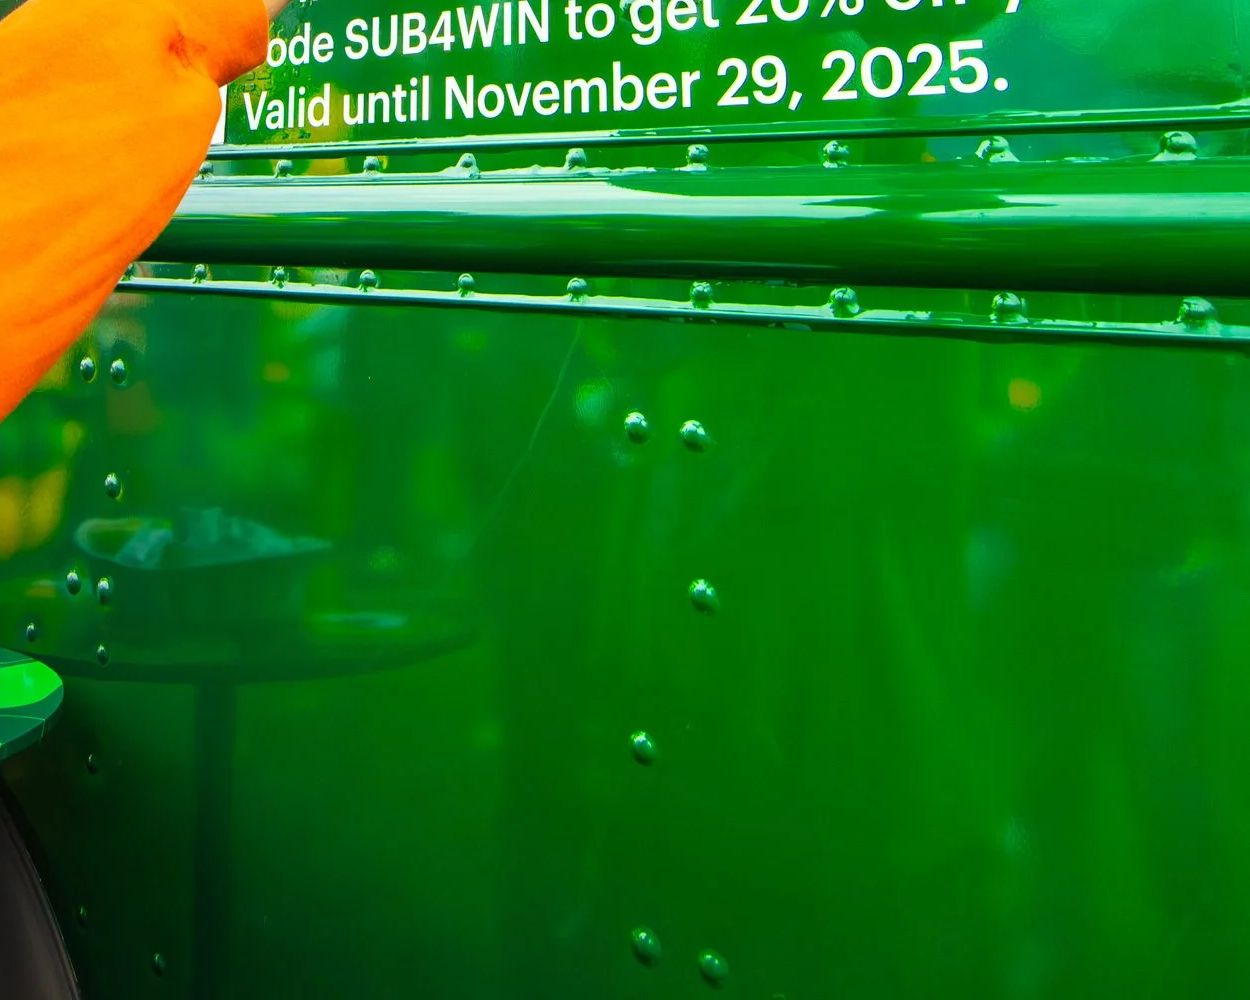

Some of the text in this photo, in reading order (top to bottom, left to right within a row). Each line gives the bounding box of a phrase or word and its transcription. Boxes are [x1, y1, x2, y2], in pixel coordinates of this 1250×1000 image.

[266, 21, 334, 68] ode
[565, 0, 615, 40] to
[242, 38, 1010, 132] Valid until November 29, 2025.
